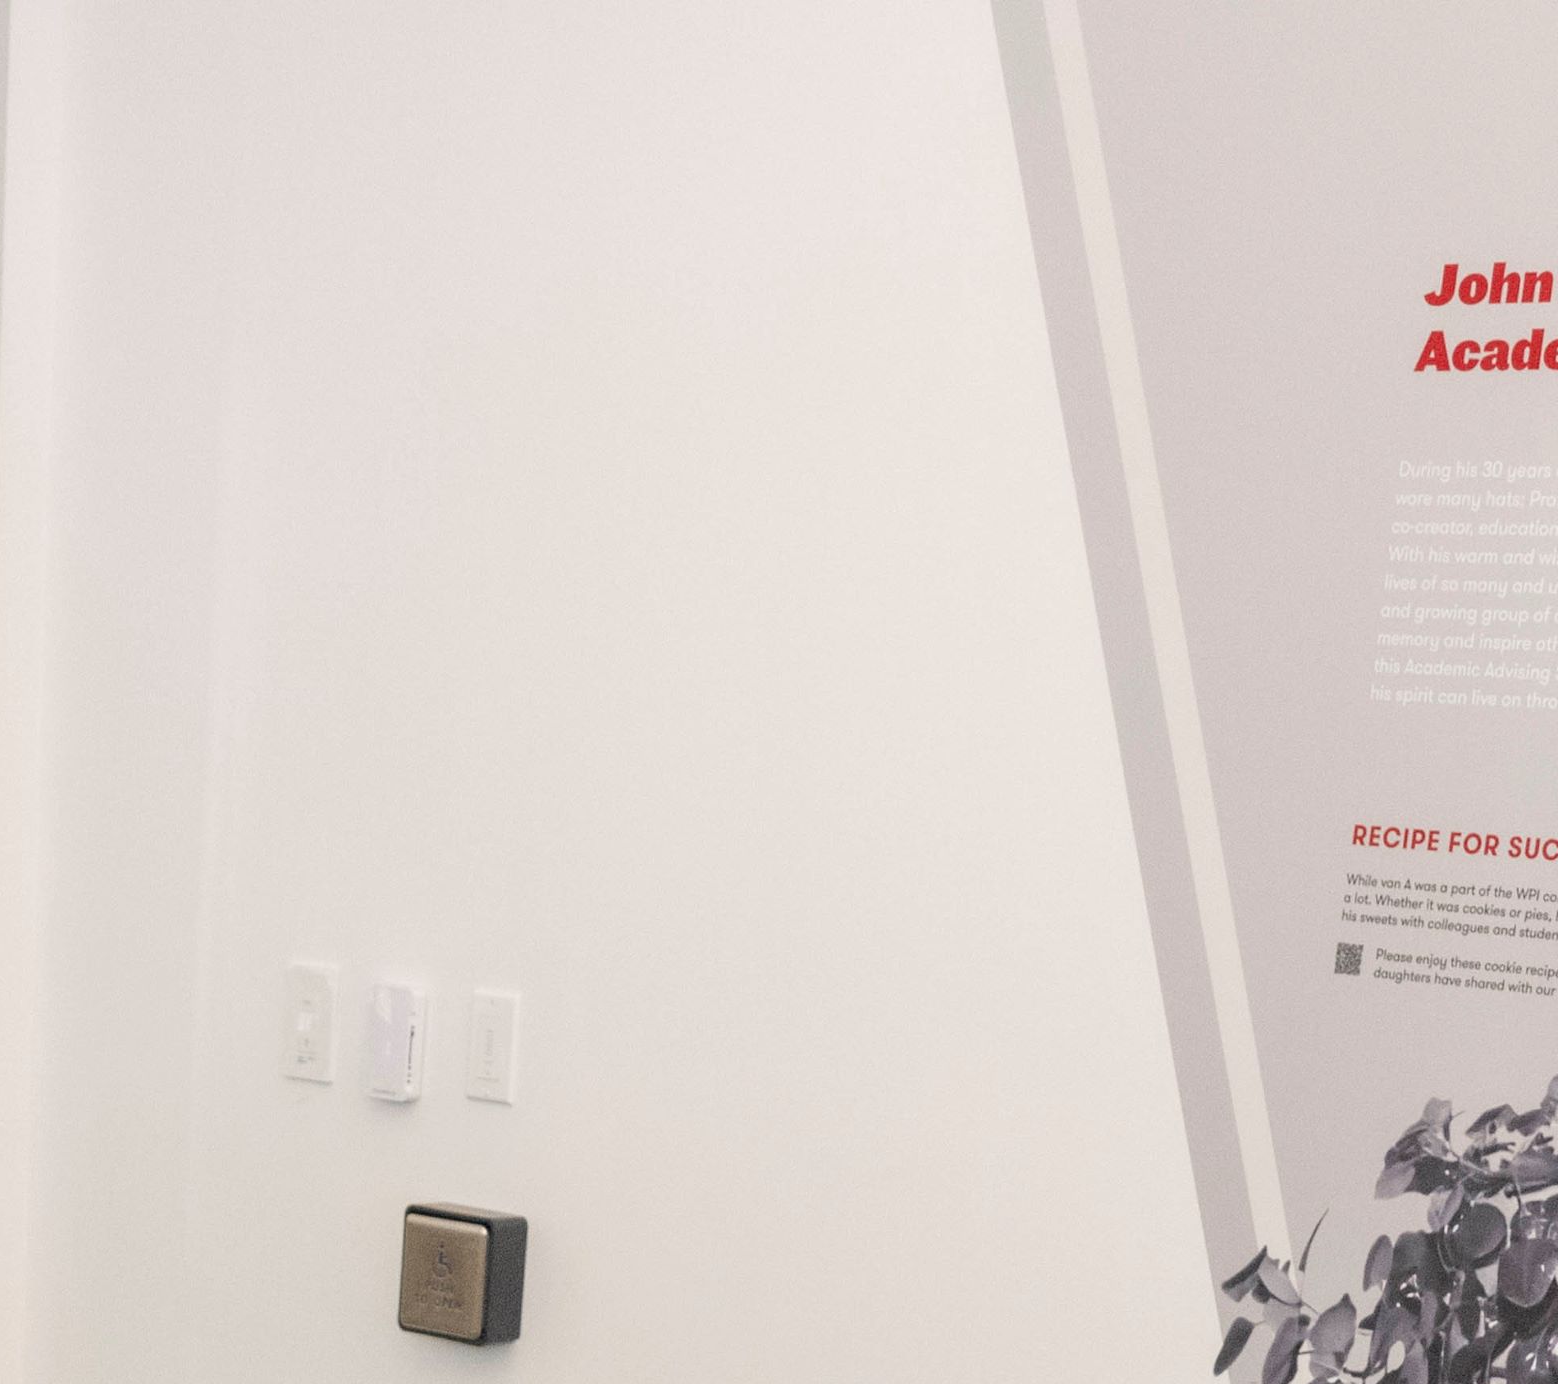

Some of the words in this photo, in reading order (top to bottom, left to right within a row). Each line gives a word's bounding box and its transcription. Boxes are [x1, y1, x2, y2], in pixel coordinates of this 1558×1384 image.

[1424, 261, 1554, 307] John
[1396, 494, 1433, 506] wore
[1437, 494, 1481, 512] many
[1486, 490, 1525, 507] hats:
[1392, 521, 1473, 536] co-creator,
[1351, 822, 1442, 852] RECIPE
[1447, 831, 1501, 857] FOR
[1347, 873, 1378, 887] While
[1381, 880, 1401, 889] van
[1403, 879, 1412, 890] A
[1414, 883, 1437, 893] was
[1440, 884, 1448, 893] a
[1450, 885, 1476, 897] part
[1478, 885, 1491, 897] of
[1494, 887, 1513, 899] the
[1516, 887, 1540, 901] WPI
[1344, 894, 1351, 903] a
[1354, 893, 1371, 905] lot.
[1375, 894, 1423, 910] Whether
[1426, 899, 1434, 911] it
[1436, 903, 1459, 913] was
[1462, 904, 1506, 917] cookies
[1509, 909, 1522, 918] or
[1524, 910, 1552, 922] pies,
[1341, 909, 1357, 922] his
[1360, 914, 1398, 926] sweets
[1401, 916, 1425, 928] with
[1427, 919, 1489, 936] colleagues
[1492, 925, 1517, 937] and
[1376, 948, 1413, 963] Please
[1415, 954, 1447, 970] enjoy
[1450, 957, 1481, 970] these
[1484, 962, 1522, 974] cookie
[1373, 967, 1431, 984] daughters
[1434, 973, 1462, 987] have
[1465, 976, 1505, 991] shared
[1508, 982, 1533, 993] with
[1535, 986, 1556, 996] our
